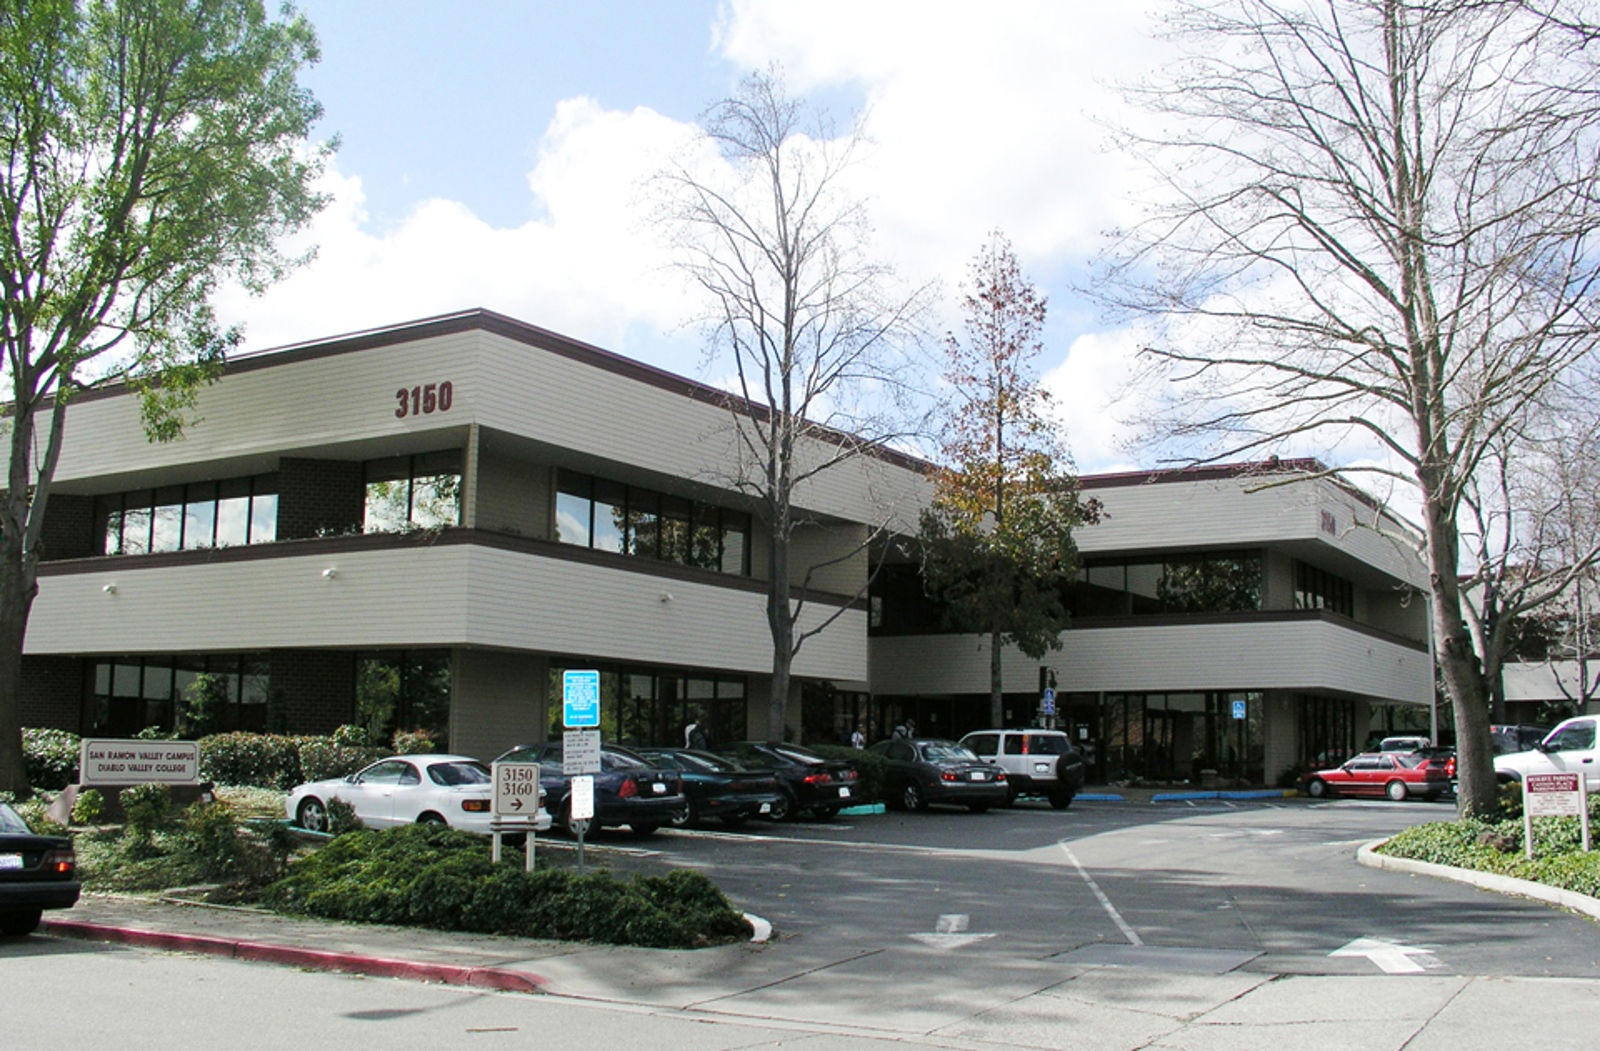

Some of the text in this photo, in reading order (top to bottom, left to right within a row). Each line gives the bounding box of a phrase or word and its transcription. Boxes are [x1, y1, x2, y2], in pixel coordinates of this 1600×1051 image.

[395, 380, 453, 419] 3150
[89, 751, 195, 761] SAN RAMON VALLEY CAMPUS
[98, 763, 187, 773] DIABLO VALLEY COLLEGE
[502, 768, 533, 781] 3150
[502, 782, 533, 795] 3160
